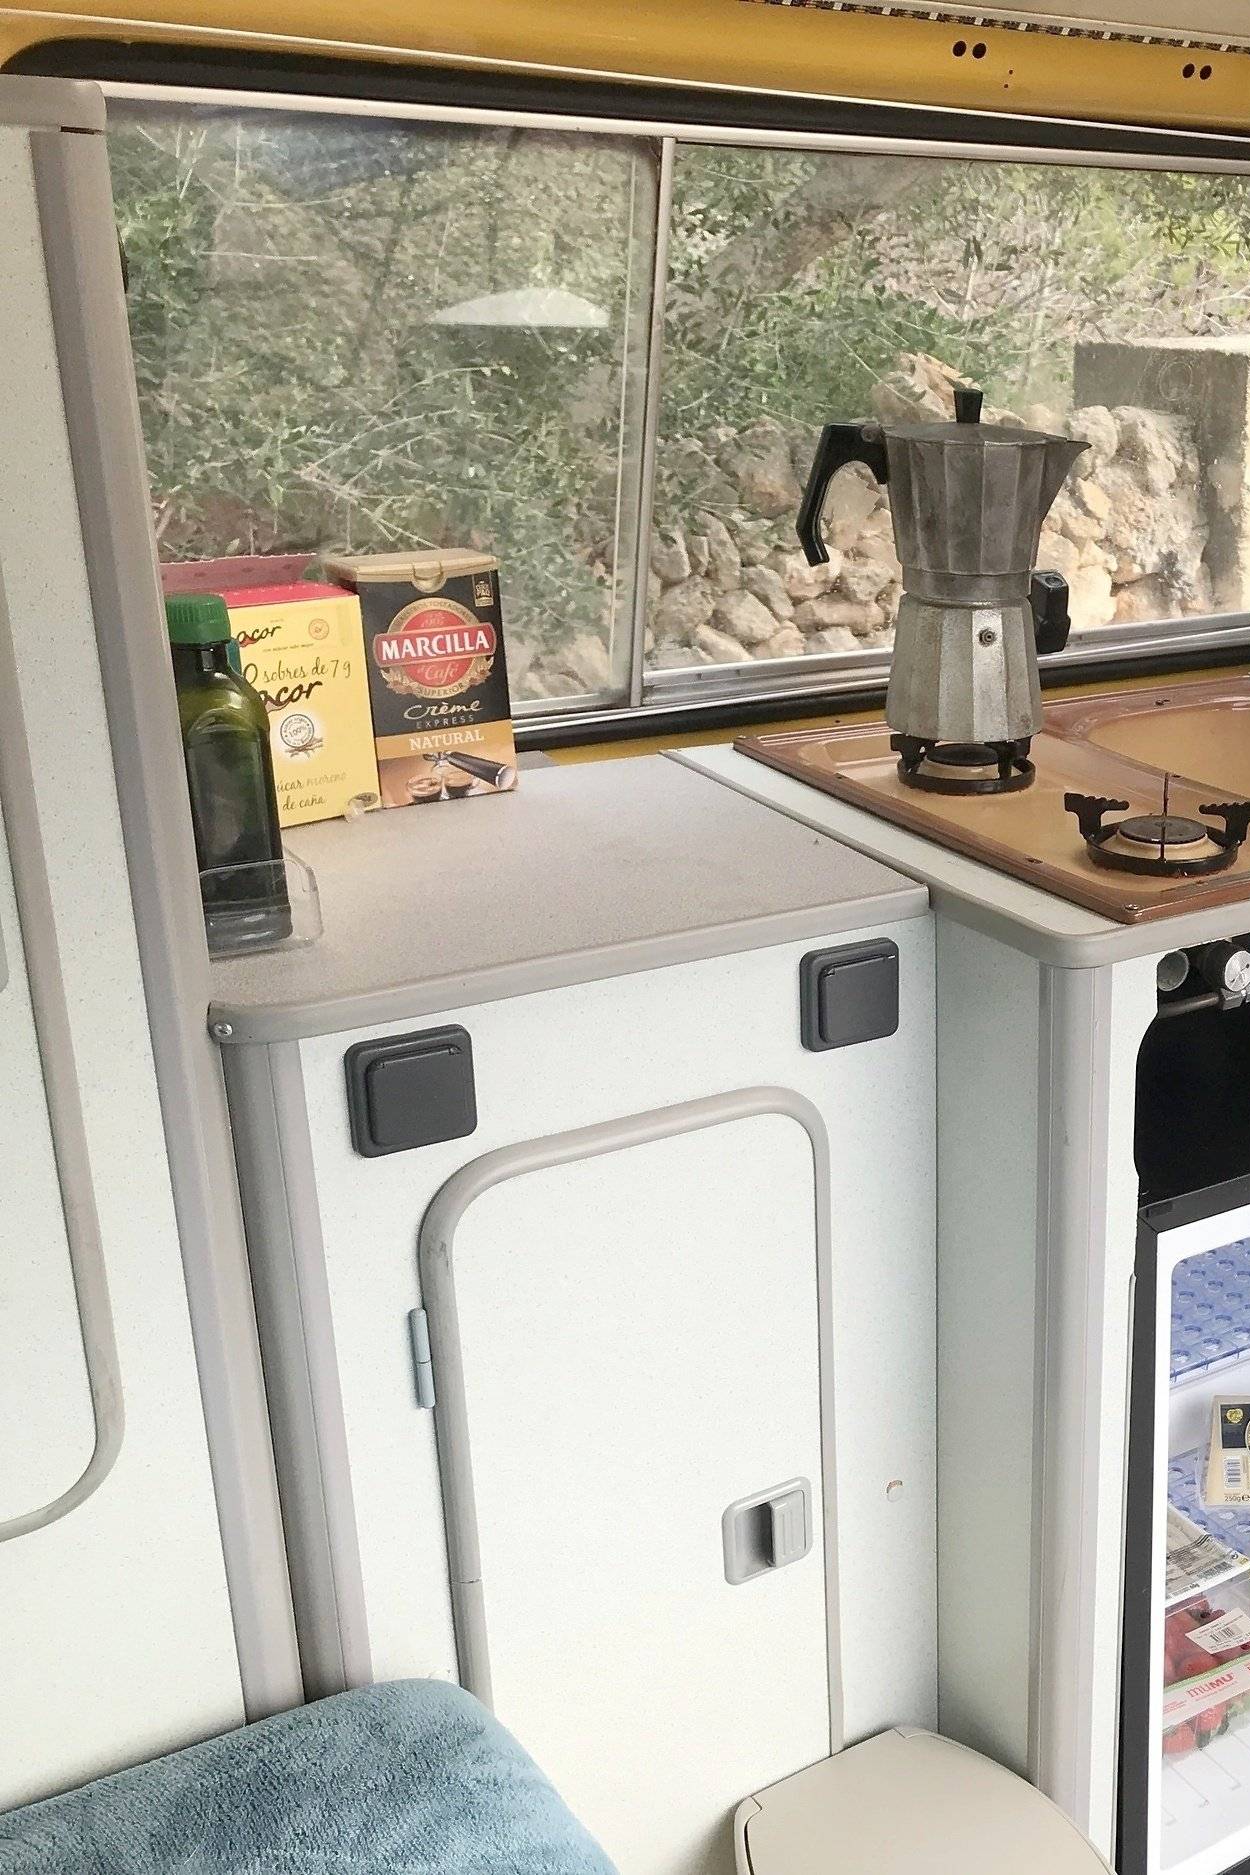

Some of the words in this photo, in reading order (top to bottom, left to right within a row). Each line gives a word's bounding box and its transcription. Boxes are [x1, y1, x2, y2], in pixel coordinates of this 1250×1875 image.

[381, 630, 490, 661] MARCILLA
[264, 660, 307, 683] sobres
[312, 656, 327, 676] de
[330, 659, 339, 678] 7
[403, 700, 482, 720] Crème
[416, 714, 474, 730] EXPRESS
[409, 730, 485, 751] NATURAL
